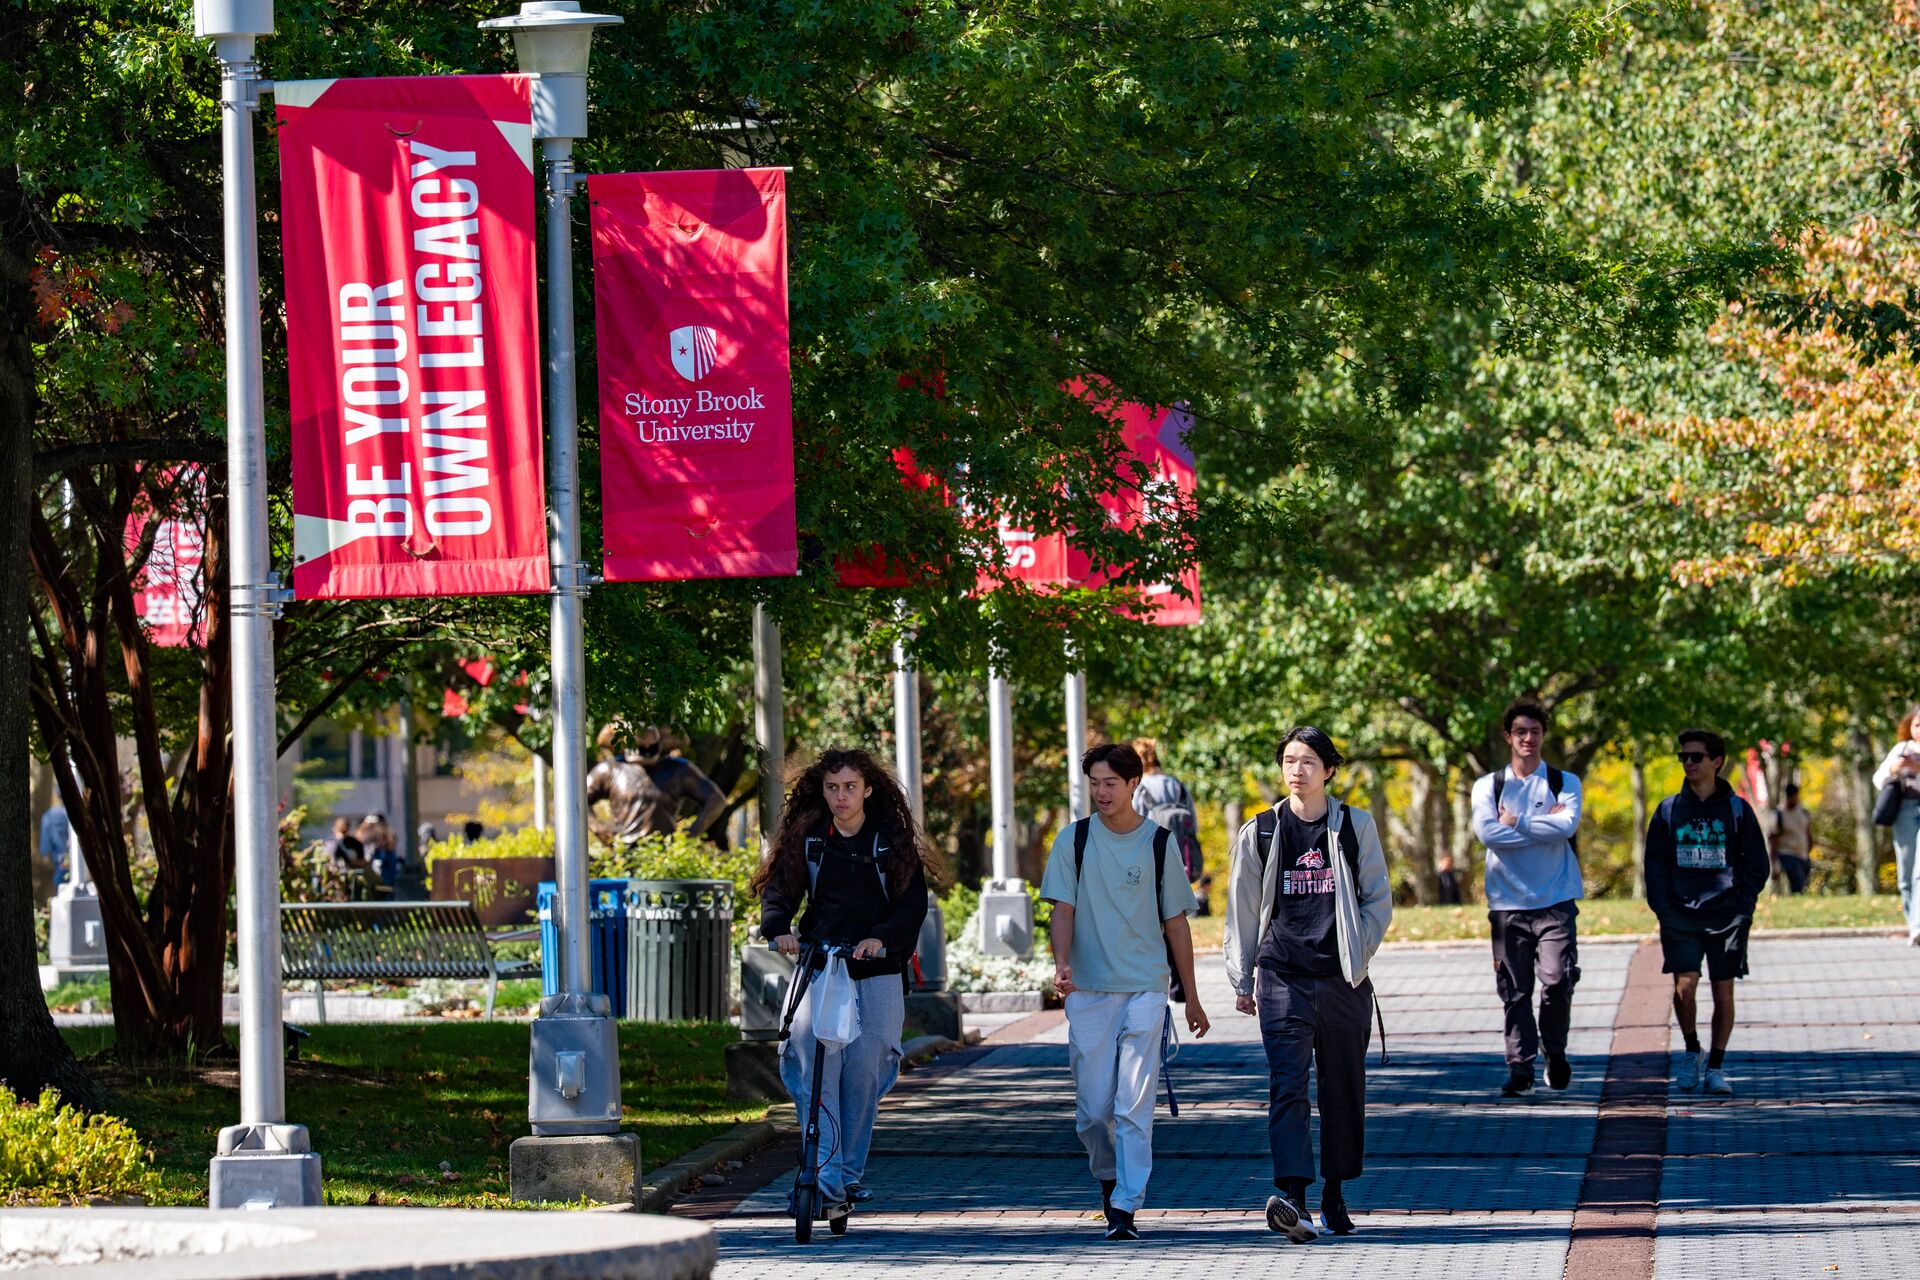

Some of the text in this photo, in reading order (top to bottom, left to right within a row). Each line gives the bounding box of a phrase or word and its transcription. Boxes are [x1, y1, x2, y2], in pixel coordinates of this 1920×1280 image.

[410, 140, 492, 537] OWN LEGACY
[340, 279, 413, 537] BE YOUR
[625, 387, 766, 419] Stony Brook
[636, 417, 755, 443] University
[145, 592, 175, 625] BE
[1291, 879, 1335, 894] FUTURE
[645, 909, 682, 920] WASTE
